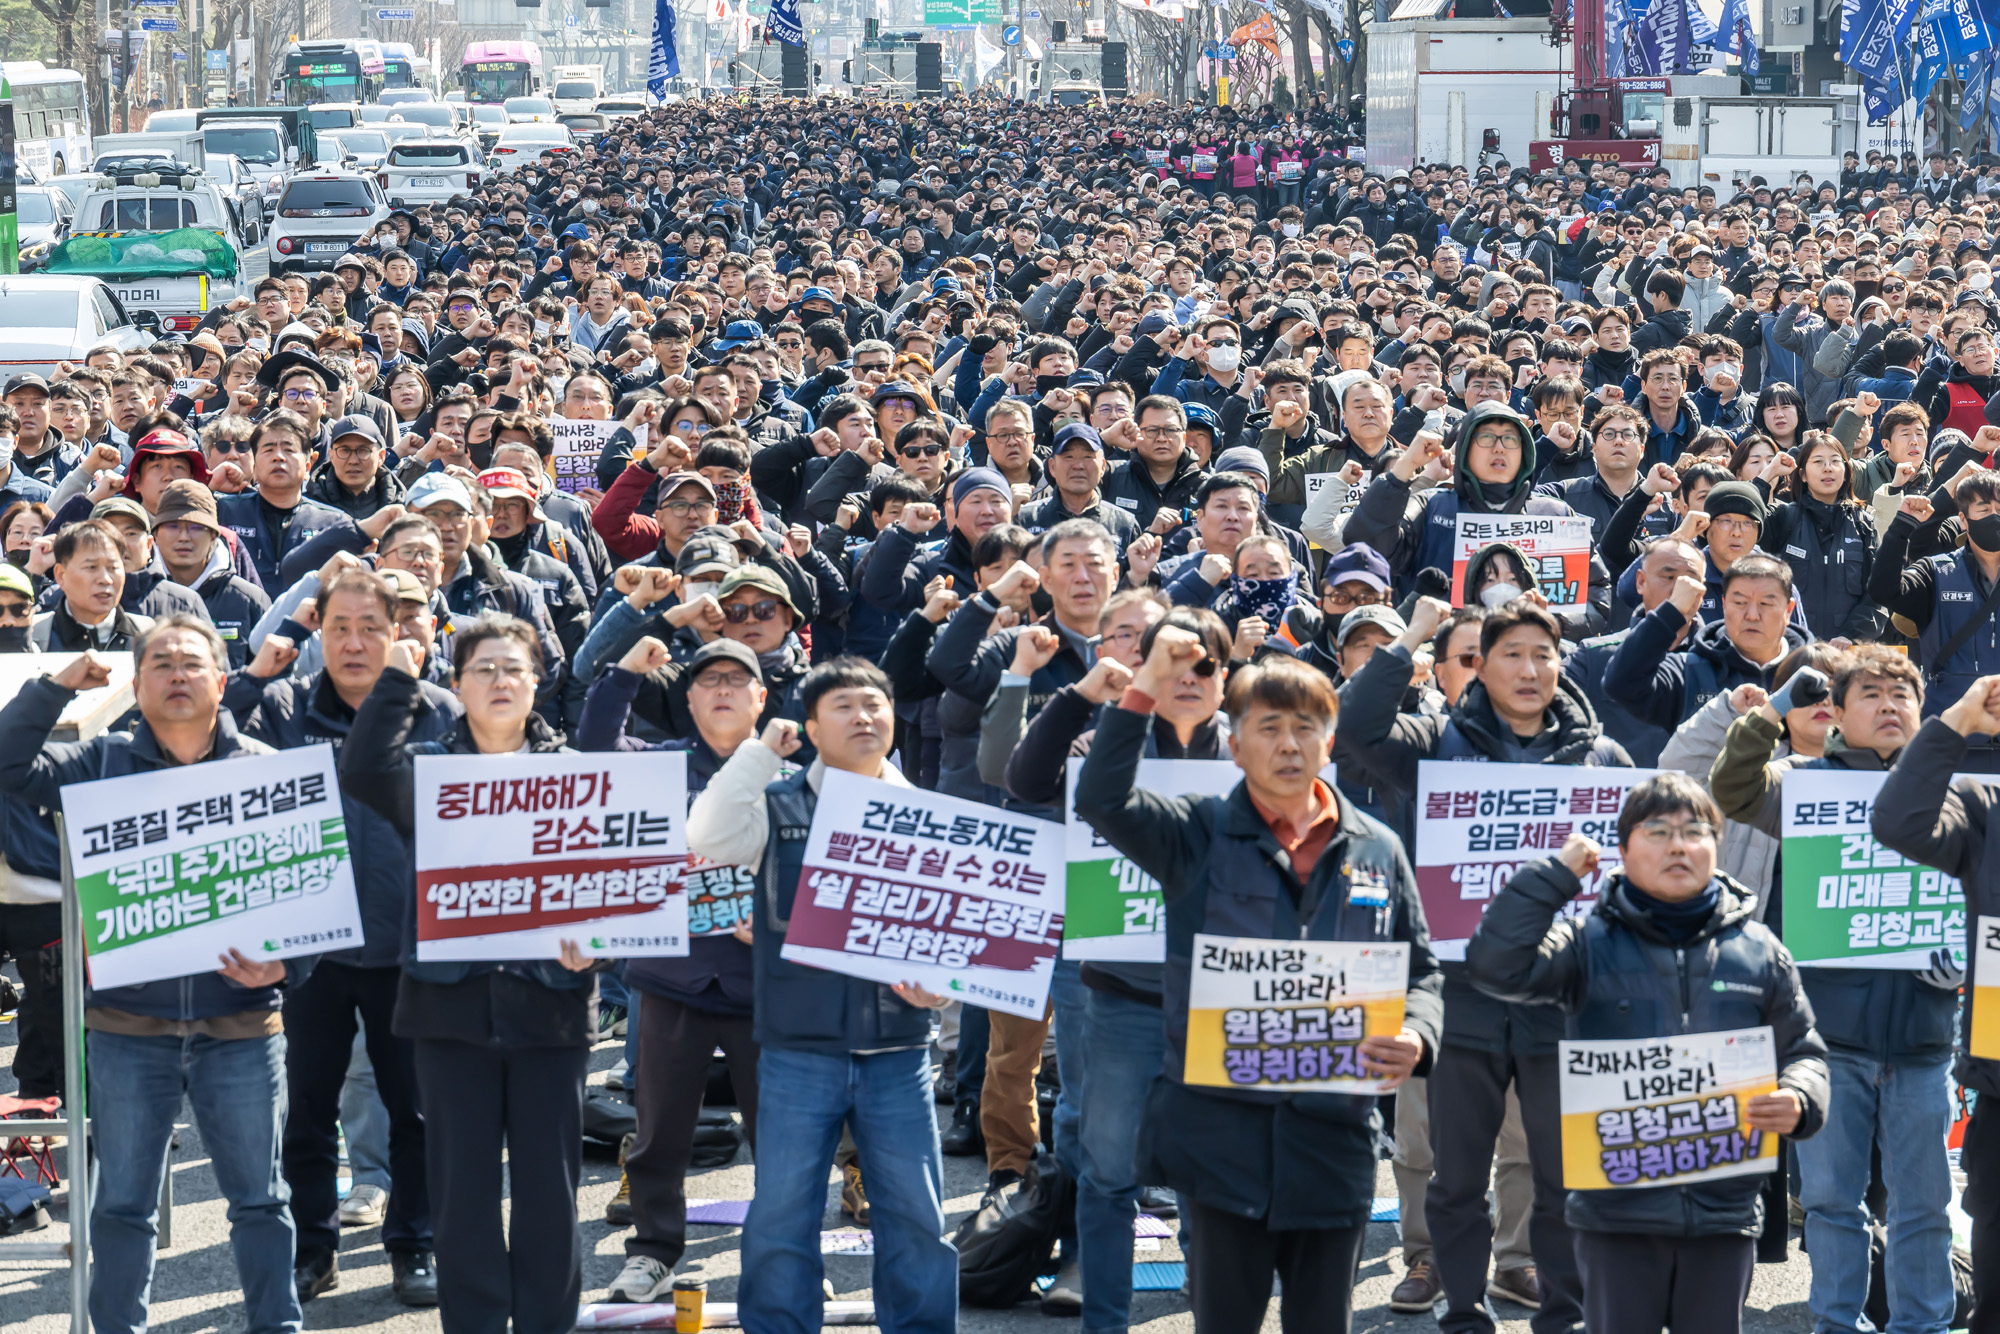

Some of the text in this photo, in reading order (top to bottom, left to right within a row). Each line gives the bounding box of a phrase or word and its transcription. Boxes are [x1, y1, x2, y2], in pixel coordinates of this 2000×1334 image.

[1754, 77, 1772, 85] VALET
[1548, 143, 1659, 164] 형 제
[1582, 153, 1621, 161] KATO
[115, 289, 161, 301] NDAI
[1461, 519, 1554, 539] 모든 노동자의
[1942, 591, 1973, 601] 단결투쟁
[437, 771, 612, 820] 중대재해가
[1425, 786, 1628, 820] 불법하도급·불법
[1793, 801, 1840, 826] 모든
[82, 772, 328, 859] 고품질 주택 건설로
[532, 810, 671, 856] 감소되는
[861, 800, 1037, 856] 건설노동자도
[179, 820, 323, 885] 주거안정에
[1467, 821, 1574, 852] 임금체불
[825, 830, 1047, 895] 빨간날 쉴 수 있는
[1817, 870, 1913, 909] 미래를
[96, 890, 211, 944] 기여하는
[852, 878, 955, 927] 권리가
[950, 896, 1051, 945] 보장된
[1200, 944, 1307, 974] 진짜사장
[1254, 971, 1348, 1002] 나와라!
[1223, 1004, 1366, 1047] 원청교섭
[1568, 1044, 1674, 1075] 진짜사장
[1624, 1060, 1718, 1102] 나와라!
[1596, 1093, 1740, 1148] 원청교섭
[1601, 1127, 1763, 1186] 쟁취하자!
